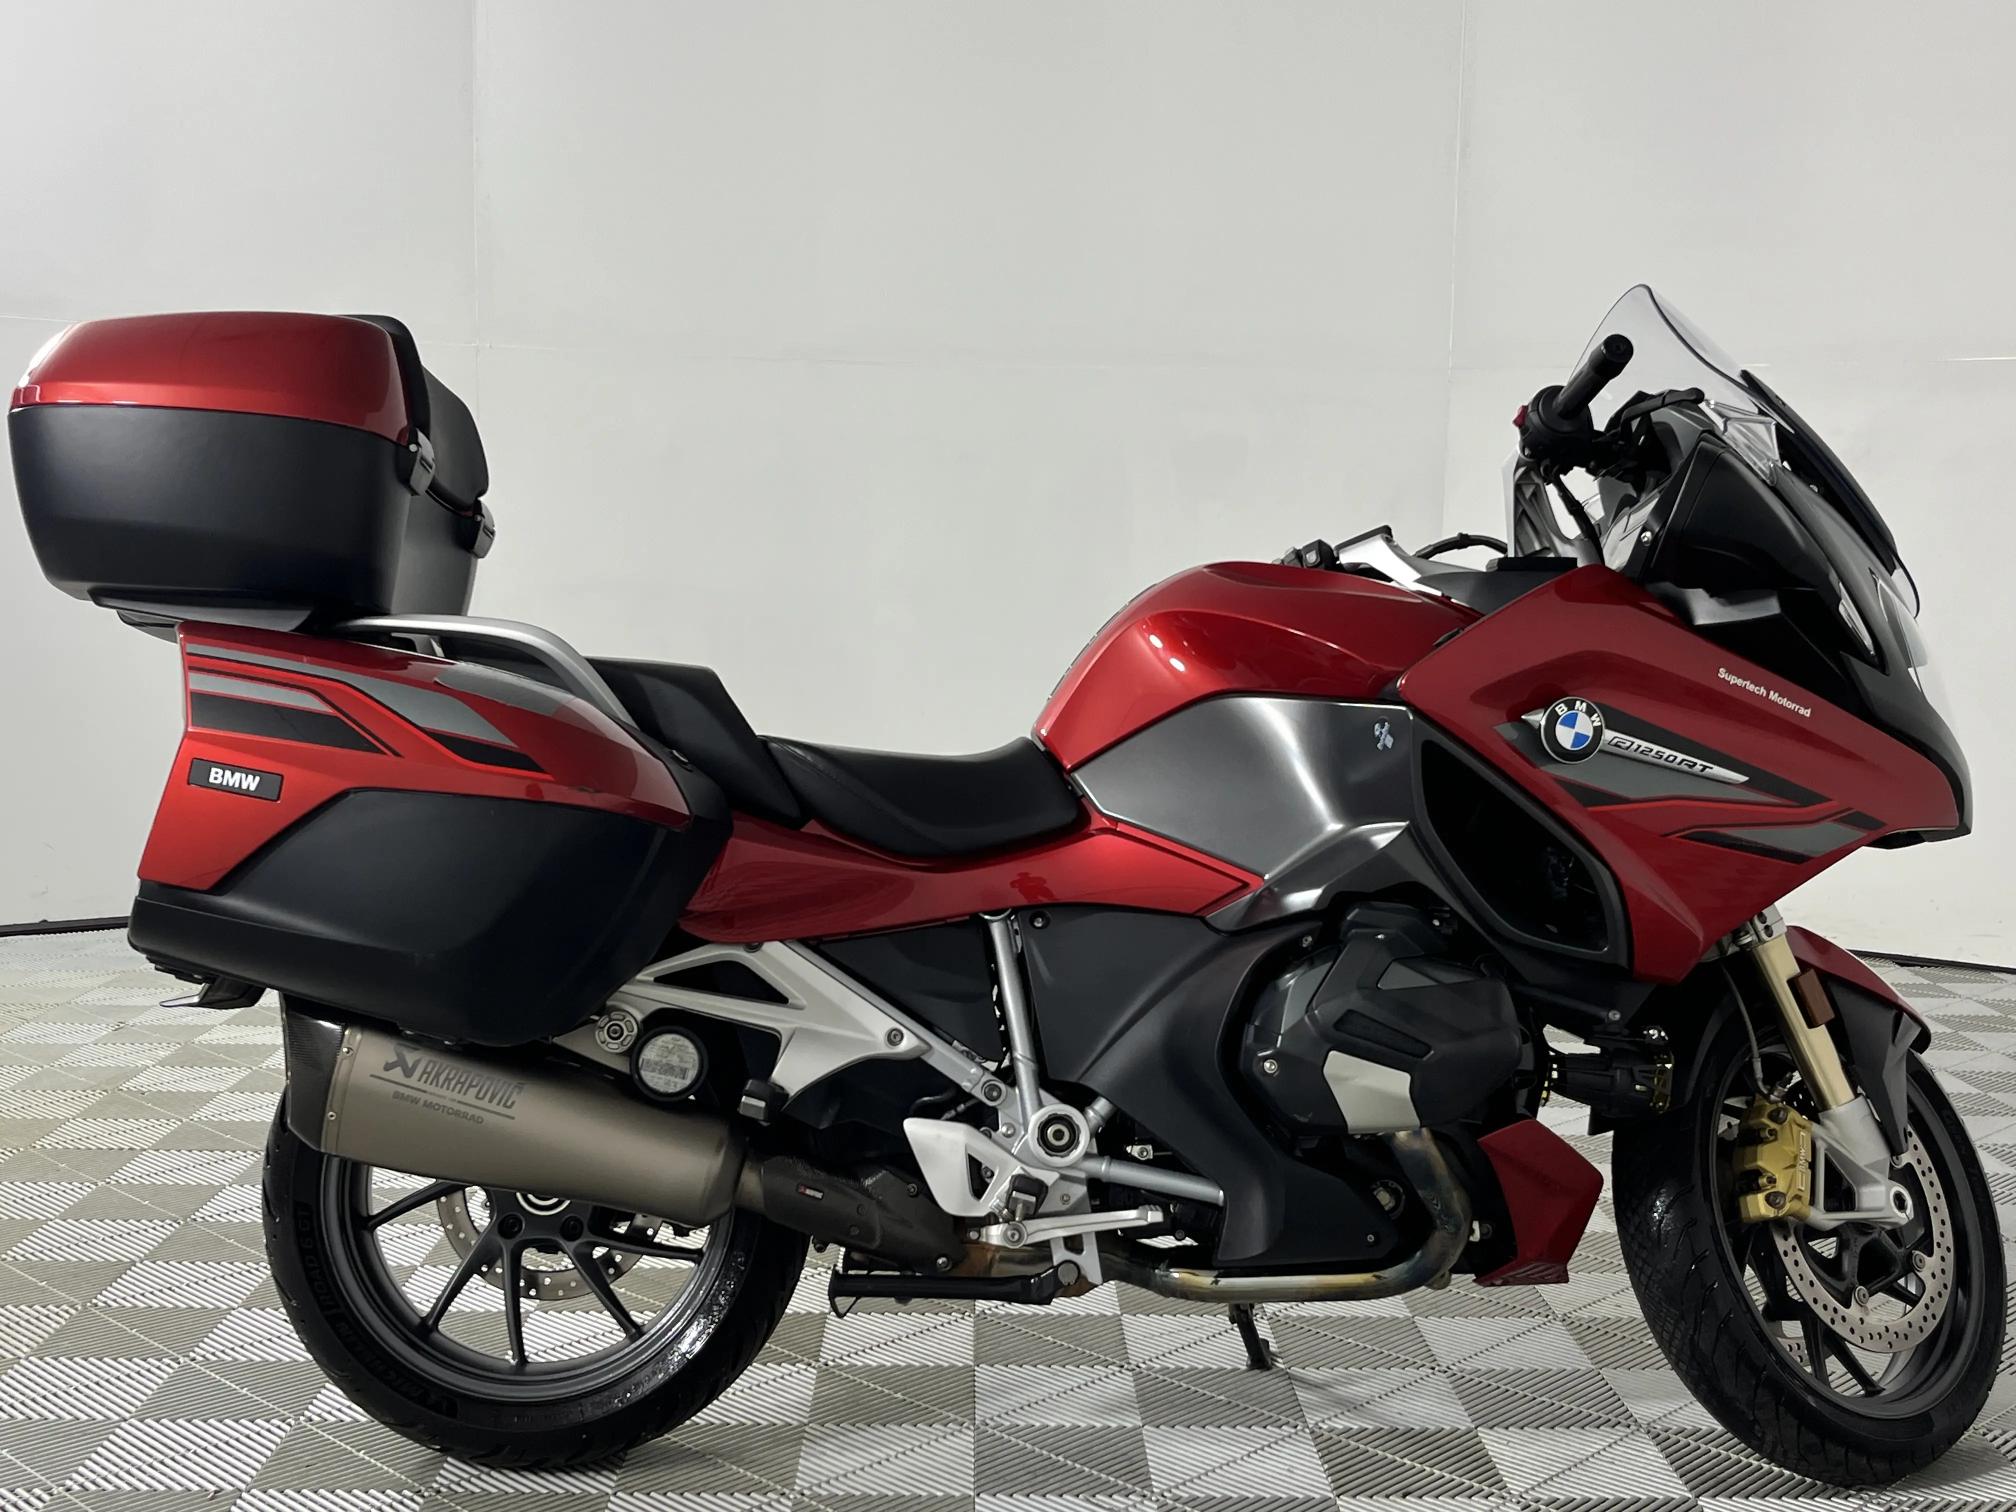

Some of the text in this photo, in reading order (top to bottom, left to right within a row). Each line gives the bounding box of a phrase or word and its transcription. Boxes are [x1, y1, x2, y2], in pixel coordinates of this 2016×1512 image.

[1717, 667, 1812, 718] Supertech Motorrad
[1555, 701, 1602, 728] BMW
[208, 767, 261, 791] BMW
[392, 1090, 485, 1124] BMW MOTORRAD
